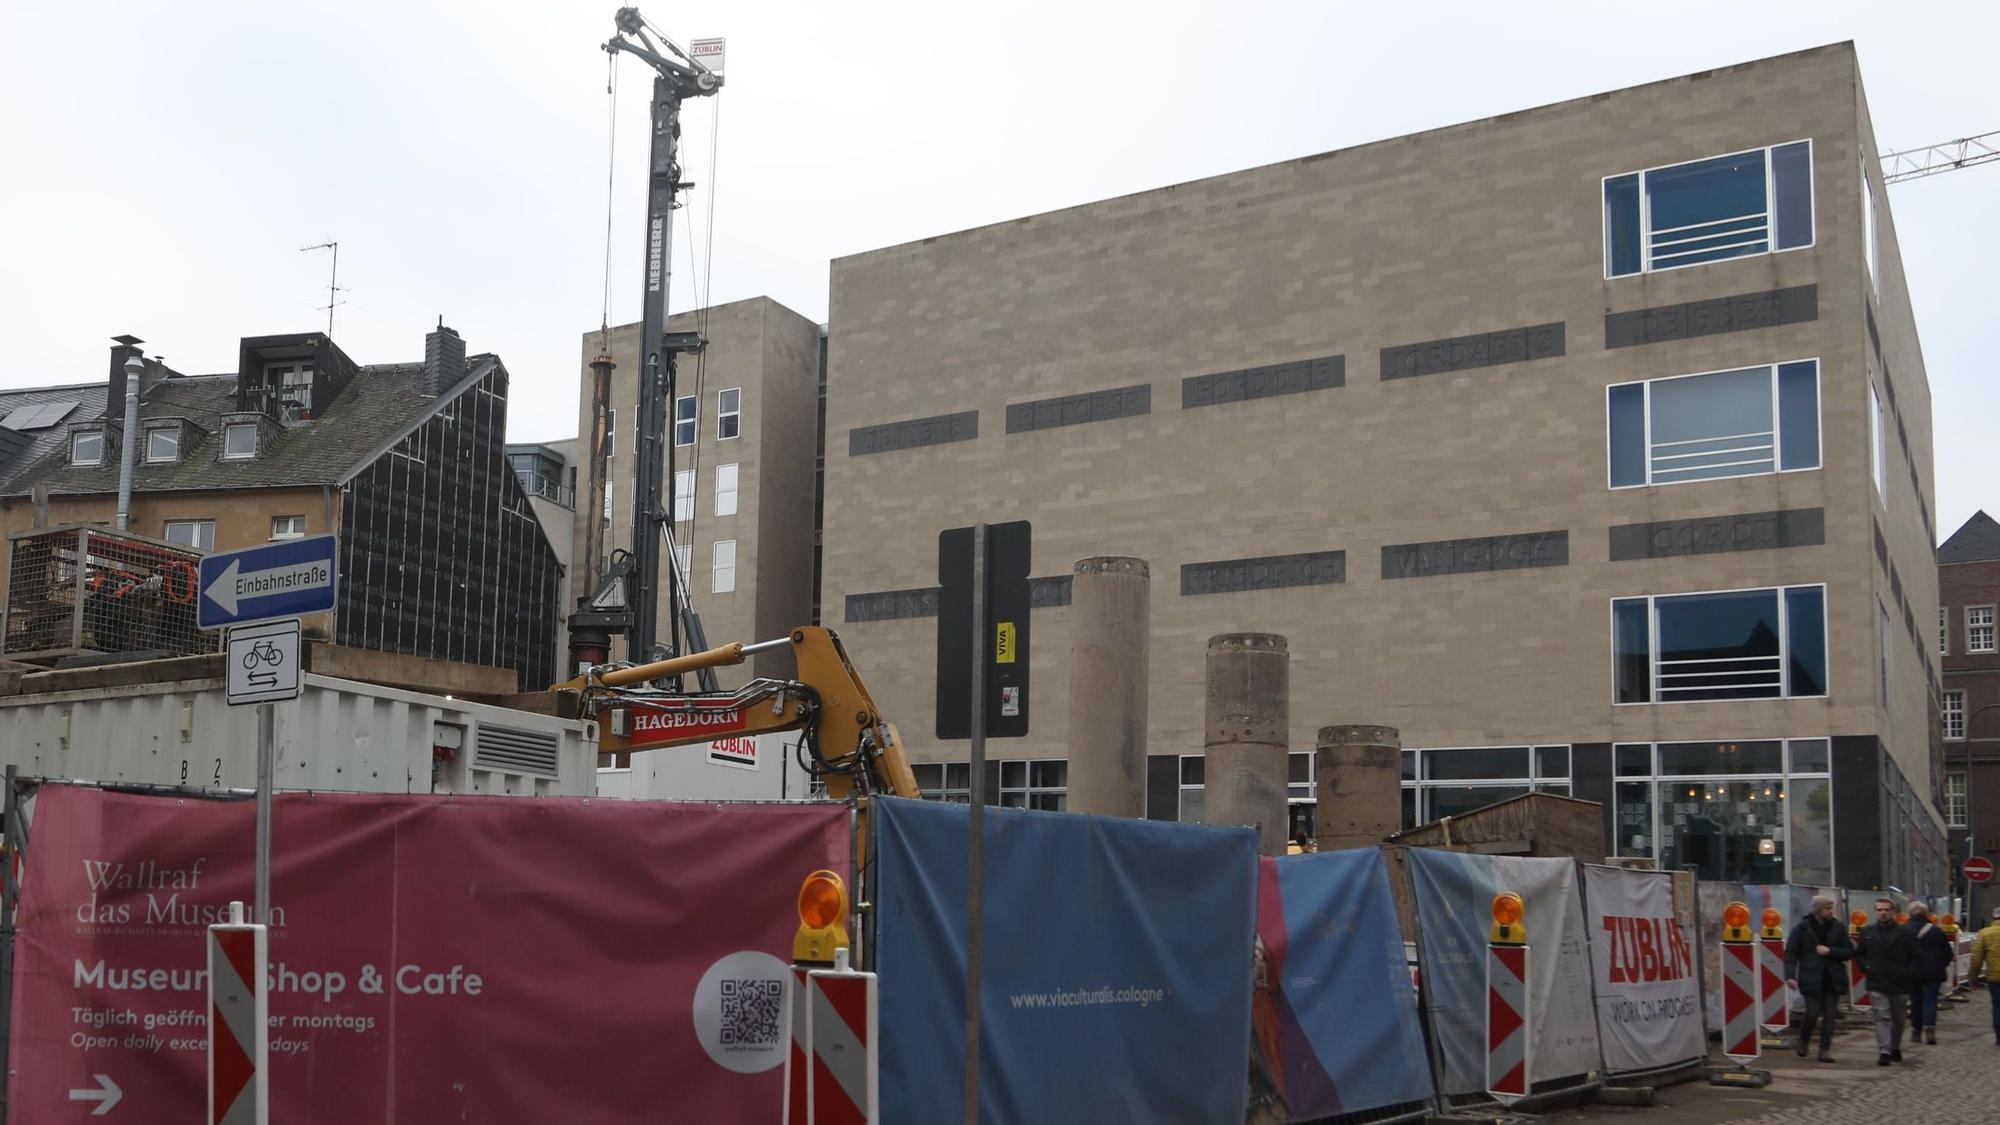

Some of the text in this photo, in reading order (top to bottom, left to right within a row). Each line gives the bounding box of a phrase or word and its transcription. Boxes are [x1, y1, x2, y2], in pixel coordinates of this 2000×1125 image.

[649, 218, 663, 292] LIEBHERR
[1388, 329, 1553, 378] JORDAENS
[1653, 518, 1778, 550] COROT
[1394, 545, 1456, 574] VAN
[235, 567, 327, 596] Einbahnstraße
[998, 630, 1007, 656] VIVA
[634, 709, 739, 731] HAGEDORN
[181, 760, 188, 780] B
[214, 758, 222, 779] 2
[83, 858, 206, 891] Wallraf
[77, 892, 131, 924] das
[358, 964, 385, 994] &
[396, 964, 484, 996] Cafe
[1010, 985, 1164, 1008] www.viaculturalis.cologne
[71, 1007, 138, 1029] Täglich
[292, 1013, 375, 1033] montags
[71, 1032, 118, 1051] Open
[124, 1034, 164, 1053] daily
[169, 1037, 208, 1051] exce
